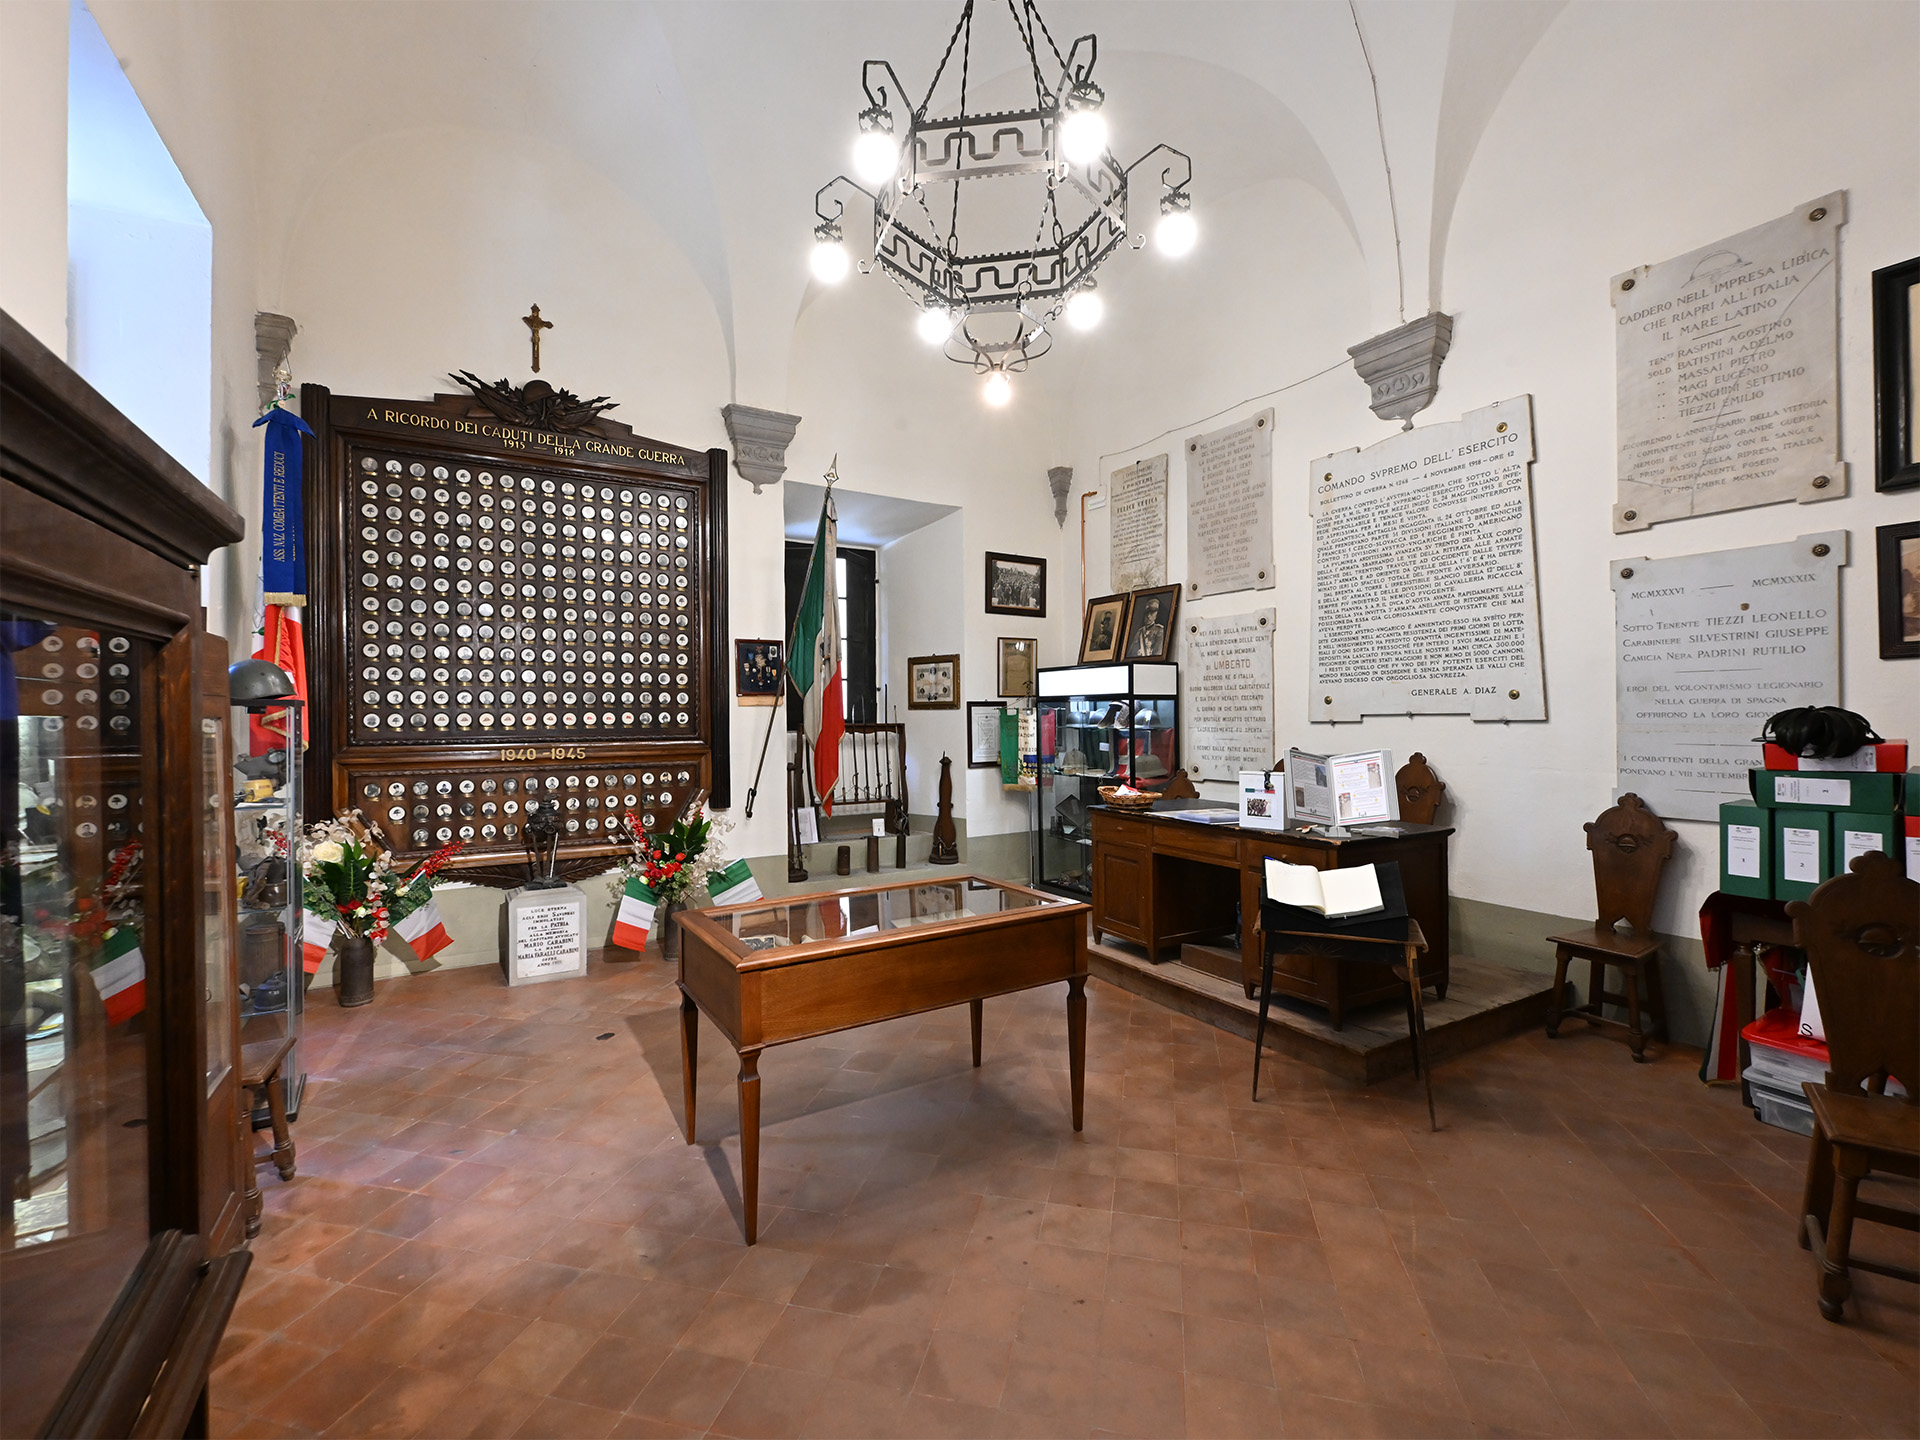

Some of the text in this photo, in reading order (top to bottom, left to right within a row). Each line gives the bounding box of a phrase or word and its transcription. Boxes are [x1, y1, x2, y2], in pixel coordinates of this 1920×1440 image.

[1618, 300, 1672, 326] CADDERO
[1714, 265, 1775, 294] IMPRESA
[1781, 246, 1830, 271] LIBICA
[1642, 316, 1666, 332] CHE
[1679, 315, 1718, 336] MARE
[1724, 297, 1777, 322] LATINO
[1677, 338, 1722, 358] RASPINI
[1728, 317, 1792, 343] AGOSTINO
[1677, 347, 1733, 370] BATISTINI
[1738, 330, 1794, 352] ADELMO
[1677, 348, 1776, 382] MASSAI PIETRO
[1677, 363, 1768, 394] MAGI EUGENIO
[1678, 366, 1805, 406] STANGHINI SETTIMIO
[1680, 390, 1764, 417] TIEZZI EMILIO
[367, 408, 685, 466] A RICORDO DEI CADUTI DELLA GRANDE GUERRA
[1733, 422, 1774, 436] GRANDE
[1779, 412, 1821, 426] GUERRA
[504, 439, 574, 456] 1915 1918
[1317, 474, 1365, 494] COMANDO
[1370, 460, 1417, 480] SVPREMO
[1458, 432, 1518, 457] ESERCITO
[274, 451, 285, 477] REDUCI
[1320, 491, 1353, 505] BOLLETTINO
[1363, 483, 1386, 494] GVERRA
[1395, 478, 1408, 486] 1268
[1430, 463, 1466, 477] NOVEMBRE
[1468, 459, 1482, 468] 1918
[1488, 453, 1504, 463] ORE
[273, 484, 285, 531] COMBATTENTI
[1330, 531, 1365, 543] GIGANTESCA
[1366, 524, 1397, 536] BATTAGLIA
[1398, 517, 1434, 529] INGAGGIATA
[1455, 506, 1487, 518] OTTOBRE
[1503, 499, 1522, 508] ALLA
[1331, 518, 1370, 531] INCROLLABILE
[1379, 511, 1402, 521] TENACE
[1405, 505, 1428, 515] VALORE
[1432, 496, 1467, 509] CONDVSSE
[1470, 484, 1521, 501] ININTERROTTA
[1630, 573, 1815, 599] MCMXXXVI MCMXXXIX
[1622, 608, 1827, 632] SOTTO TENENTE TIEZZI LEONELLO
[1622, 626, 1829, 647] CARABINIERE SILVESTRINI GIUSEPPE
[1213, 658, 1250, 670] UMBERTO
[1622, 644, 1806, 662] CAMICIA NERA PADRINI RUTILIO
[1674, 683, 1752, 691] VOLONTARISMO
[1757, 681, 1824, 689] LEGIONARIO
[501, 748, 537, 761] 1940
